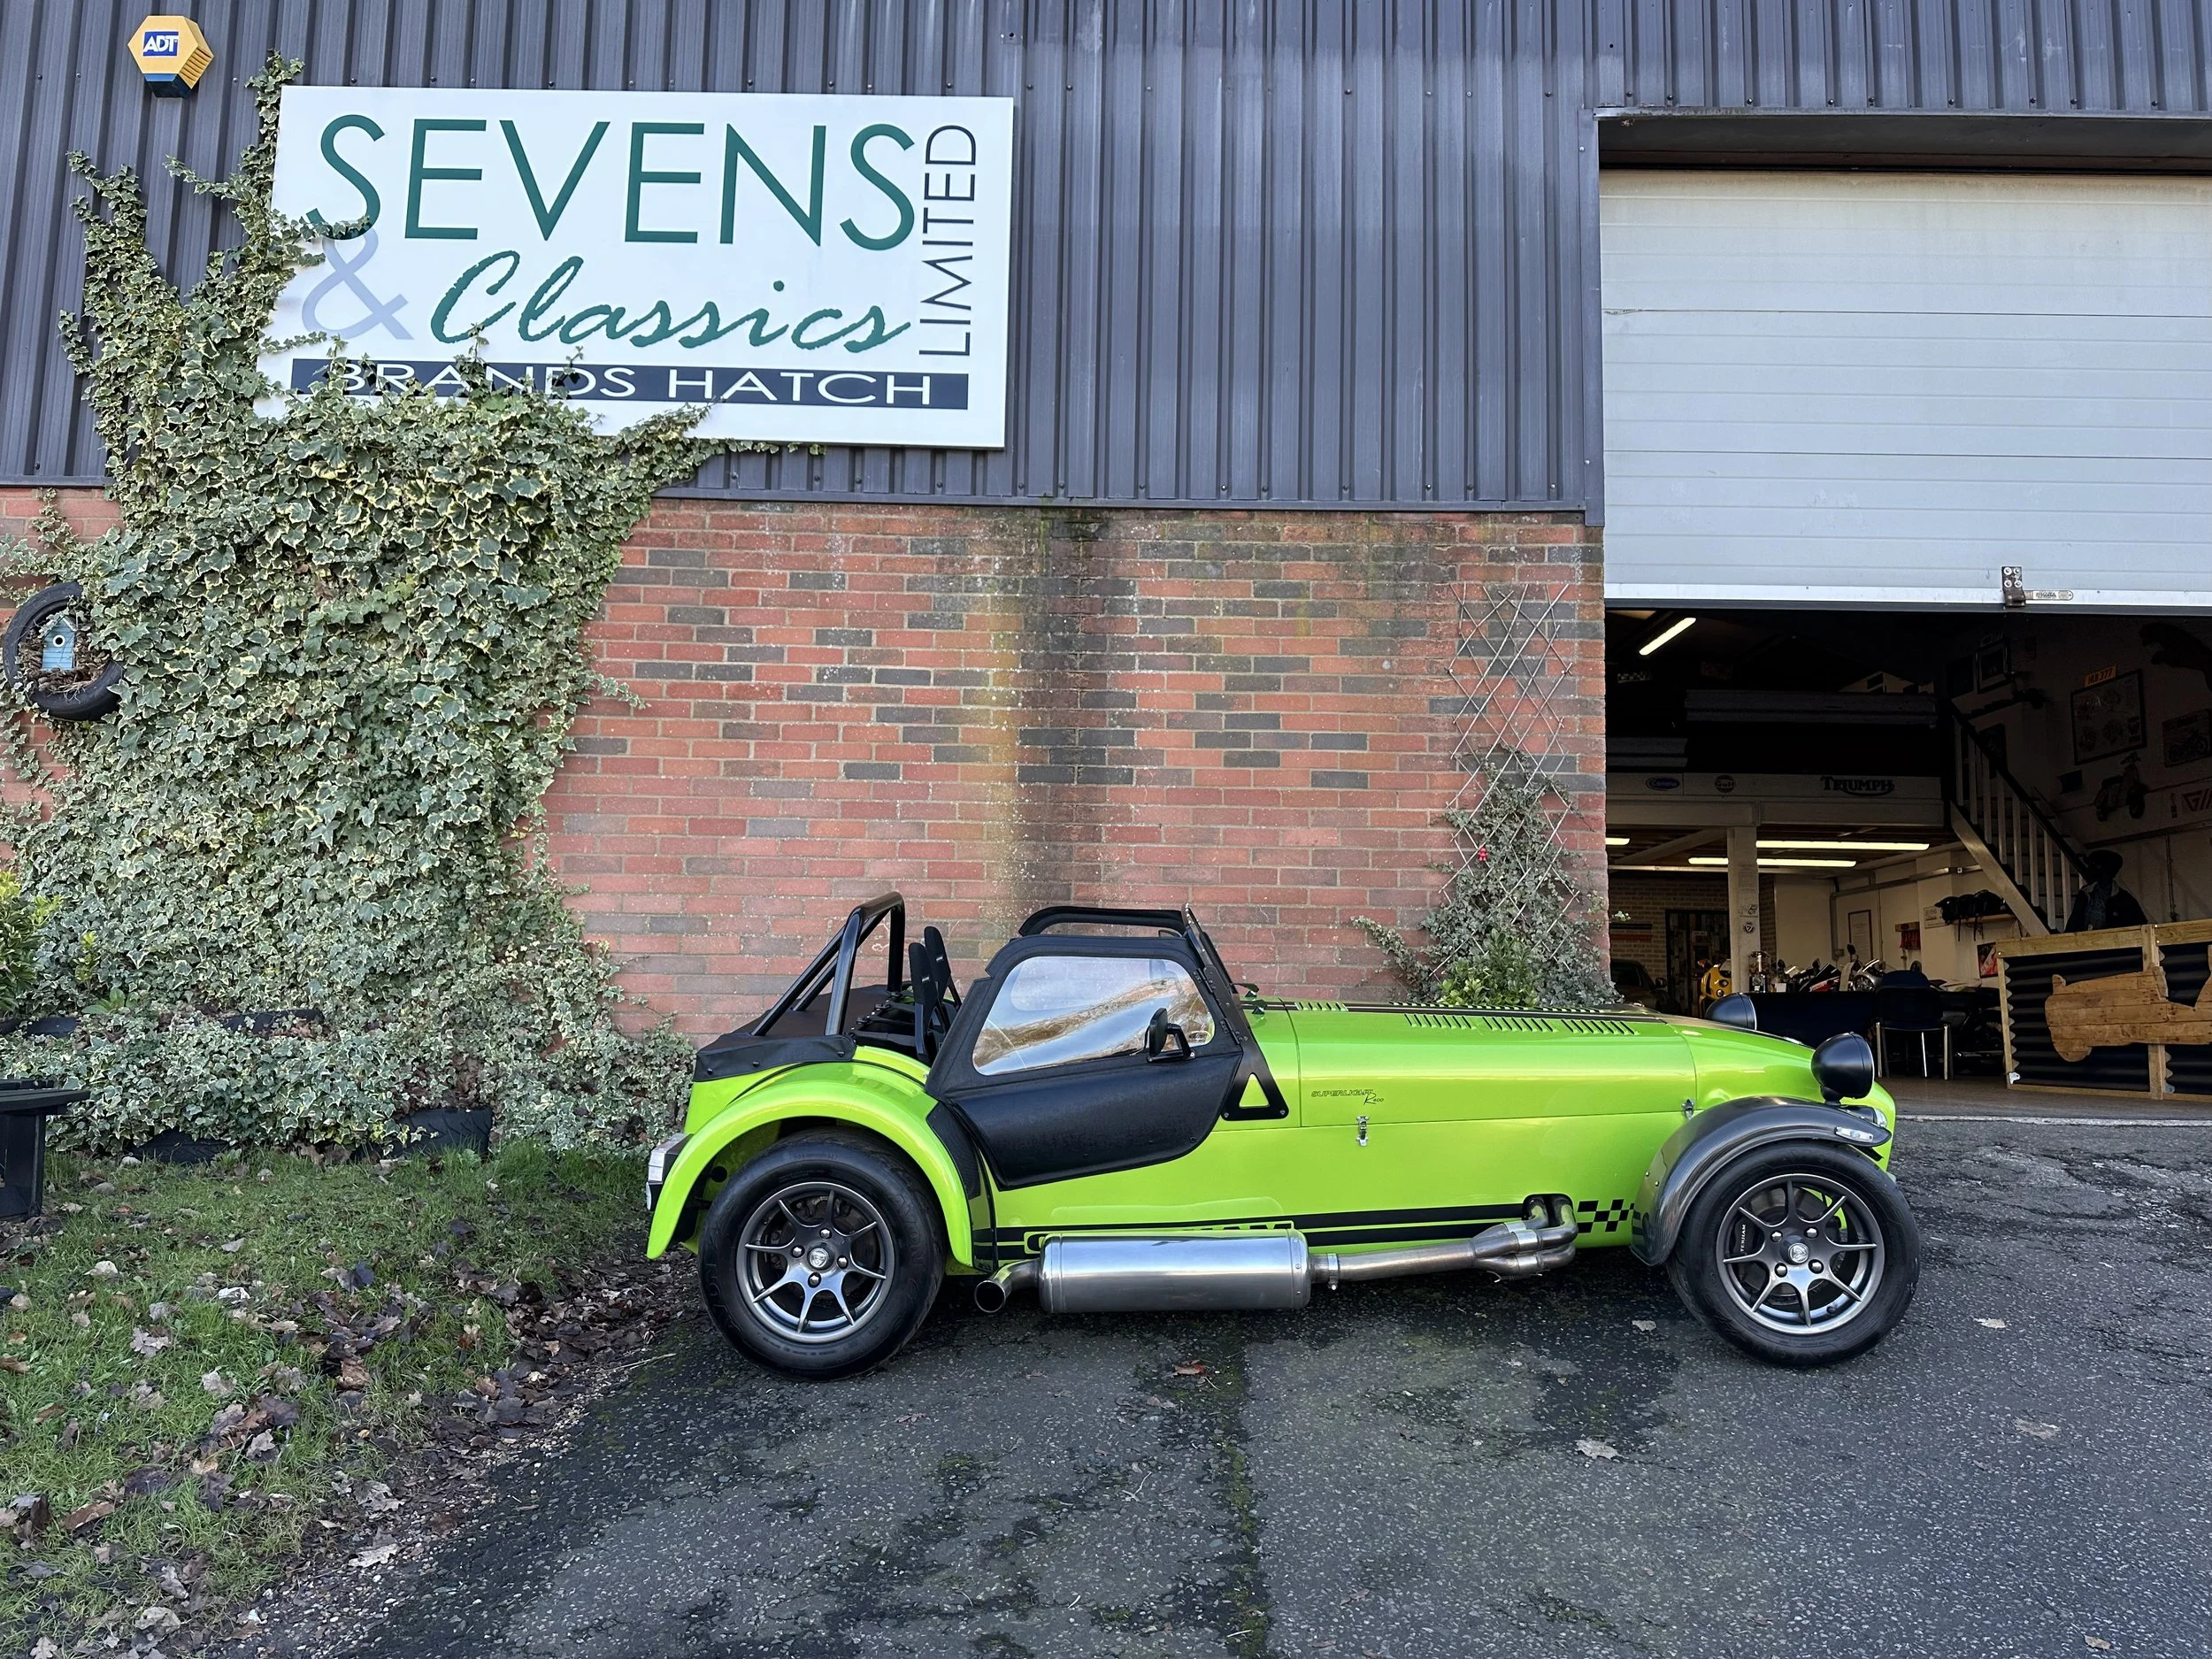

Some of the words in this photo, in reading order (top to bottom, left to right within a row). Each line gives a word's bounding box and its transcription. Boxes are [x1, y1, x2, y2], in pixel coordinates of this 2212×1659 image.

[142, 35, 179, 52] ADT
[307, 114, 915, 250] SEVENS
[919, 125, 976, 357] LIMITED
[303, 229, 413, 340] &
[431, 250, 910, 353] Classics
[669, 369, 931, 405] HATCH
[1820, 776, 1894, 795] TRIUMPH
